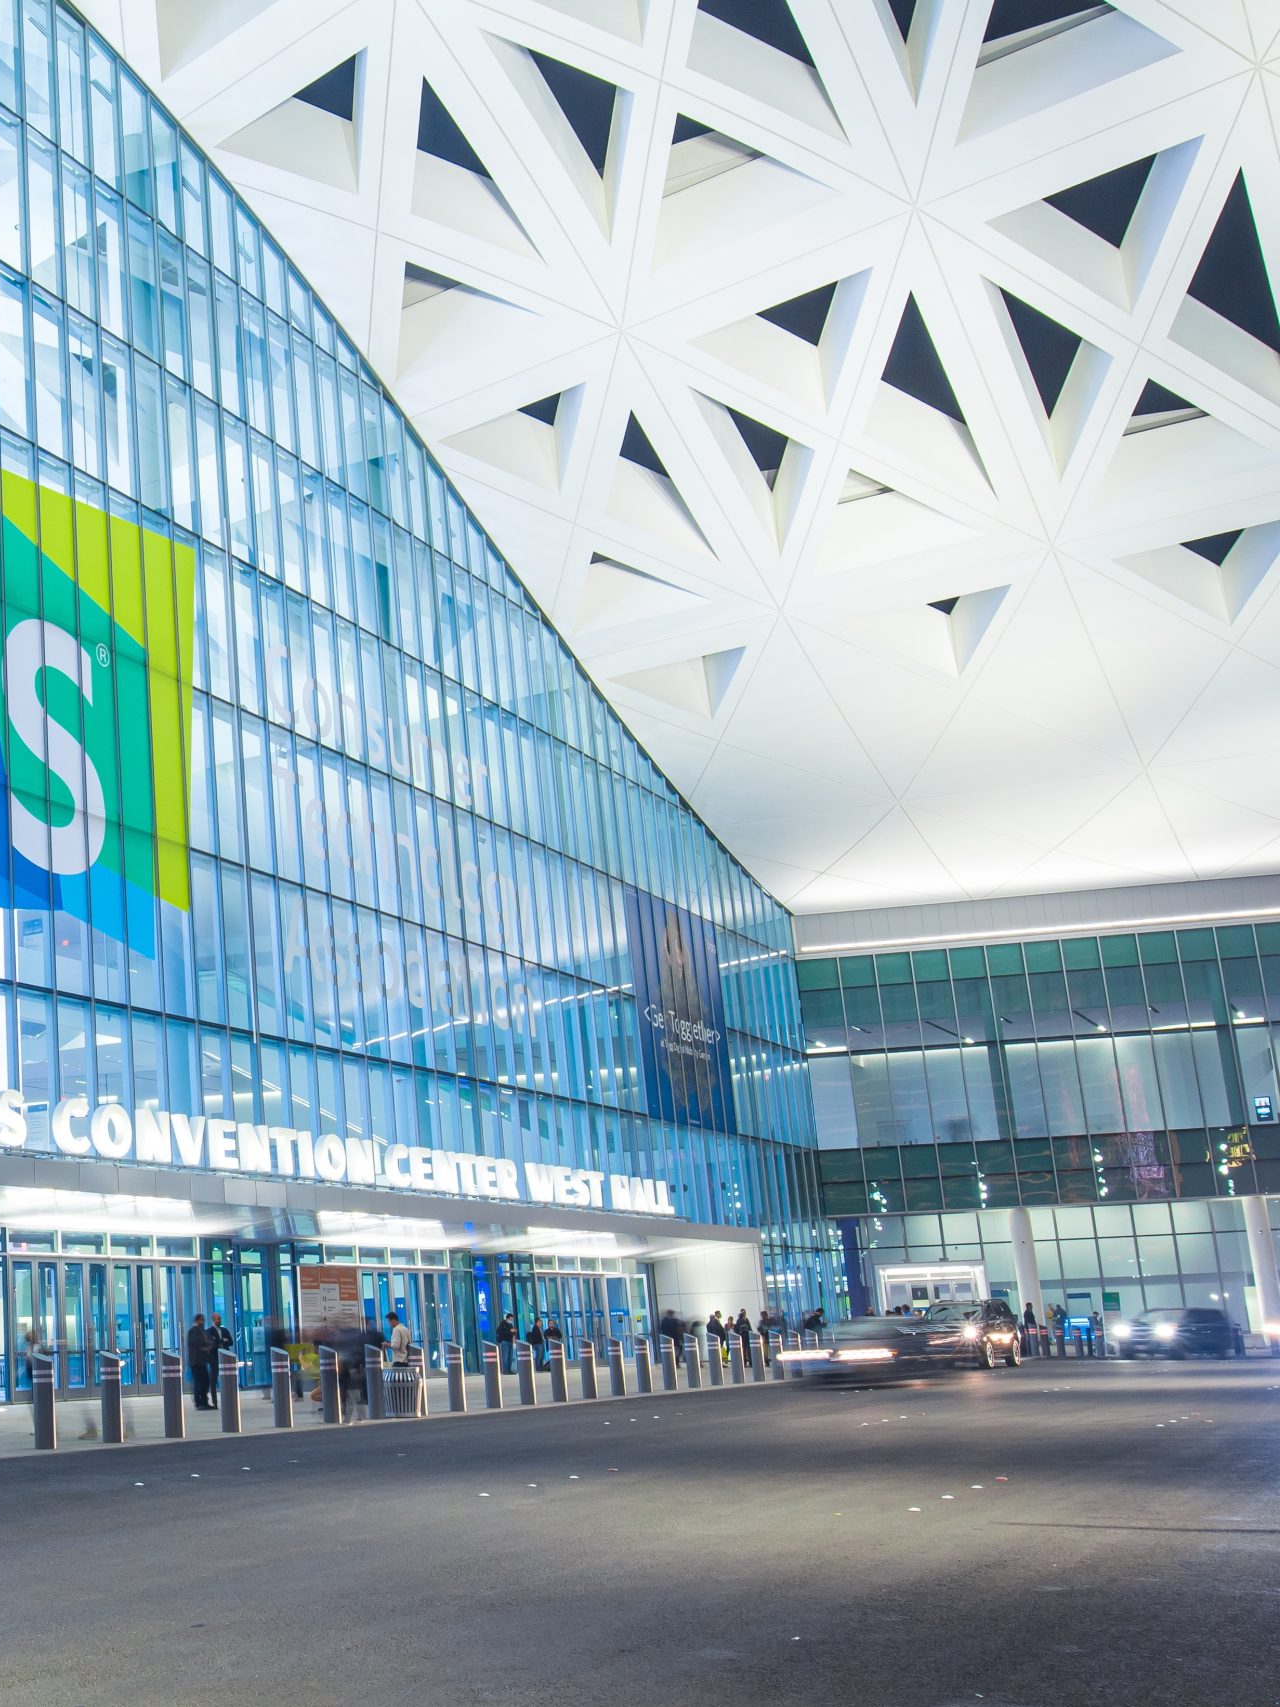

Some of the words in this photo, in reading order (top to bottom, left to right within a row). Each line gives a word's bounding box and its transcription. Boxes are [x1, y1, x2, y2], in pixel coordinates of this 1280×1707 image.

[52, 1097, 381, 1184] CONVENTION
[384, 1143, 519, 1199] CENTER
[524, 1162, 604, 1208] WEST
[610, 1174, 675, 1215] HALL
